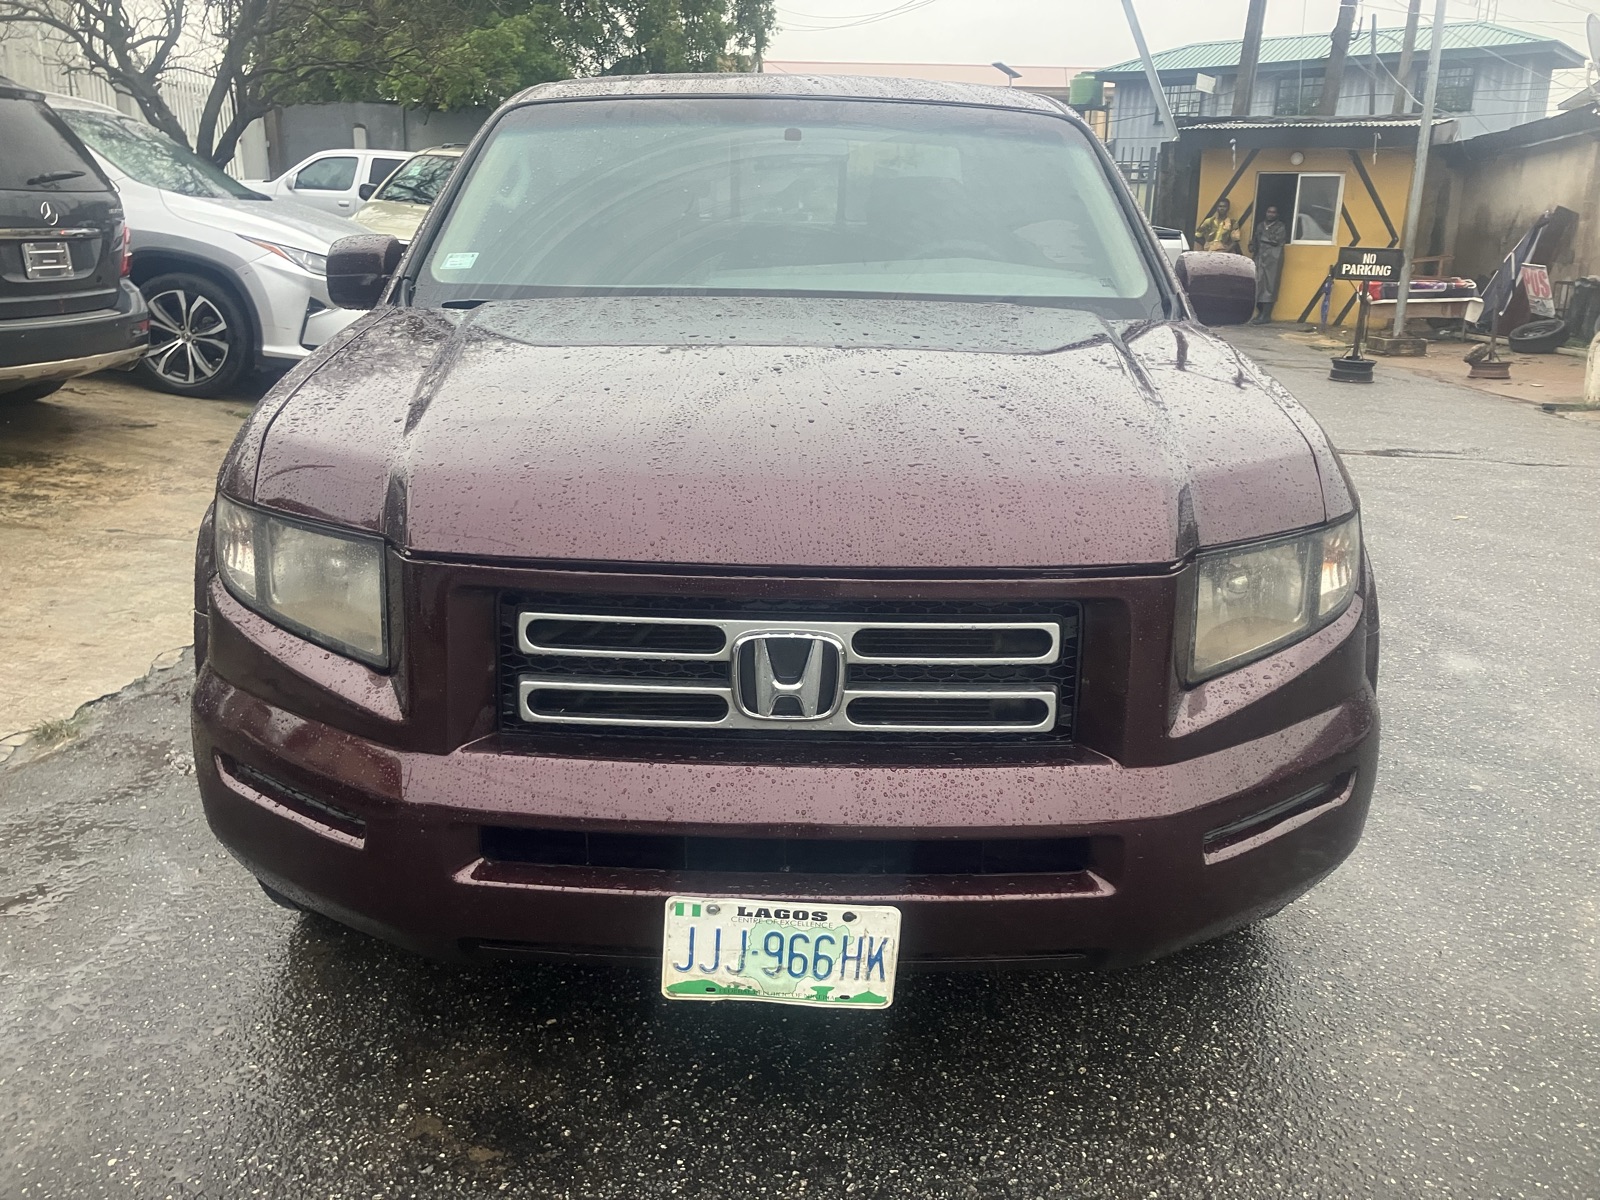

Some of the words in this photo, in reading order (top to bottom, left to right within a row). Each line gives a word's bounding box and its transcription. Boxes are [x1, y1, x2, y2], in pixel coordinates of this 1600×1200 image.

[1362, 253, 1377, 264] NO
[1341, 264, 1392, 276] PARKING
[737, 907, 828, 921] LAGOS
[780, 919, 834, 928] EXCELLENCE
[673, 927, 888, 981] JJJ-966HK
